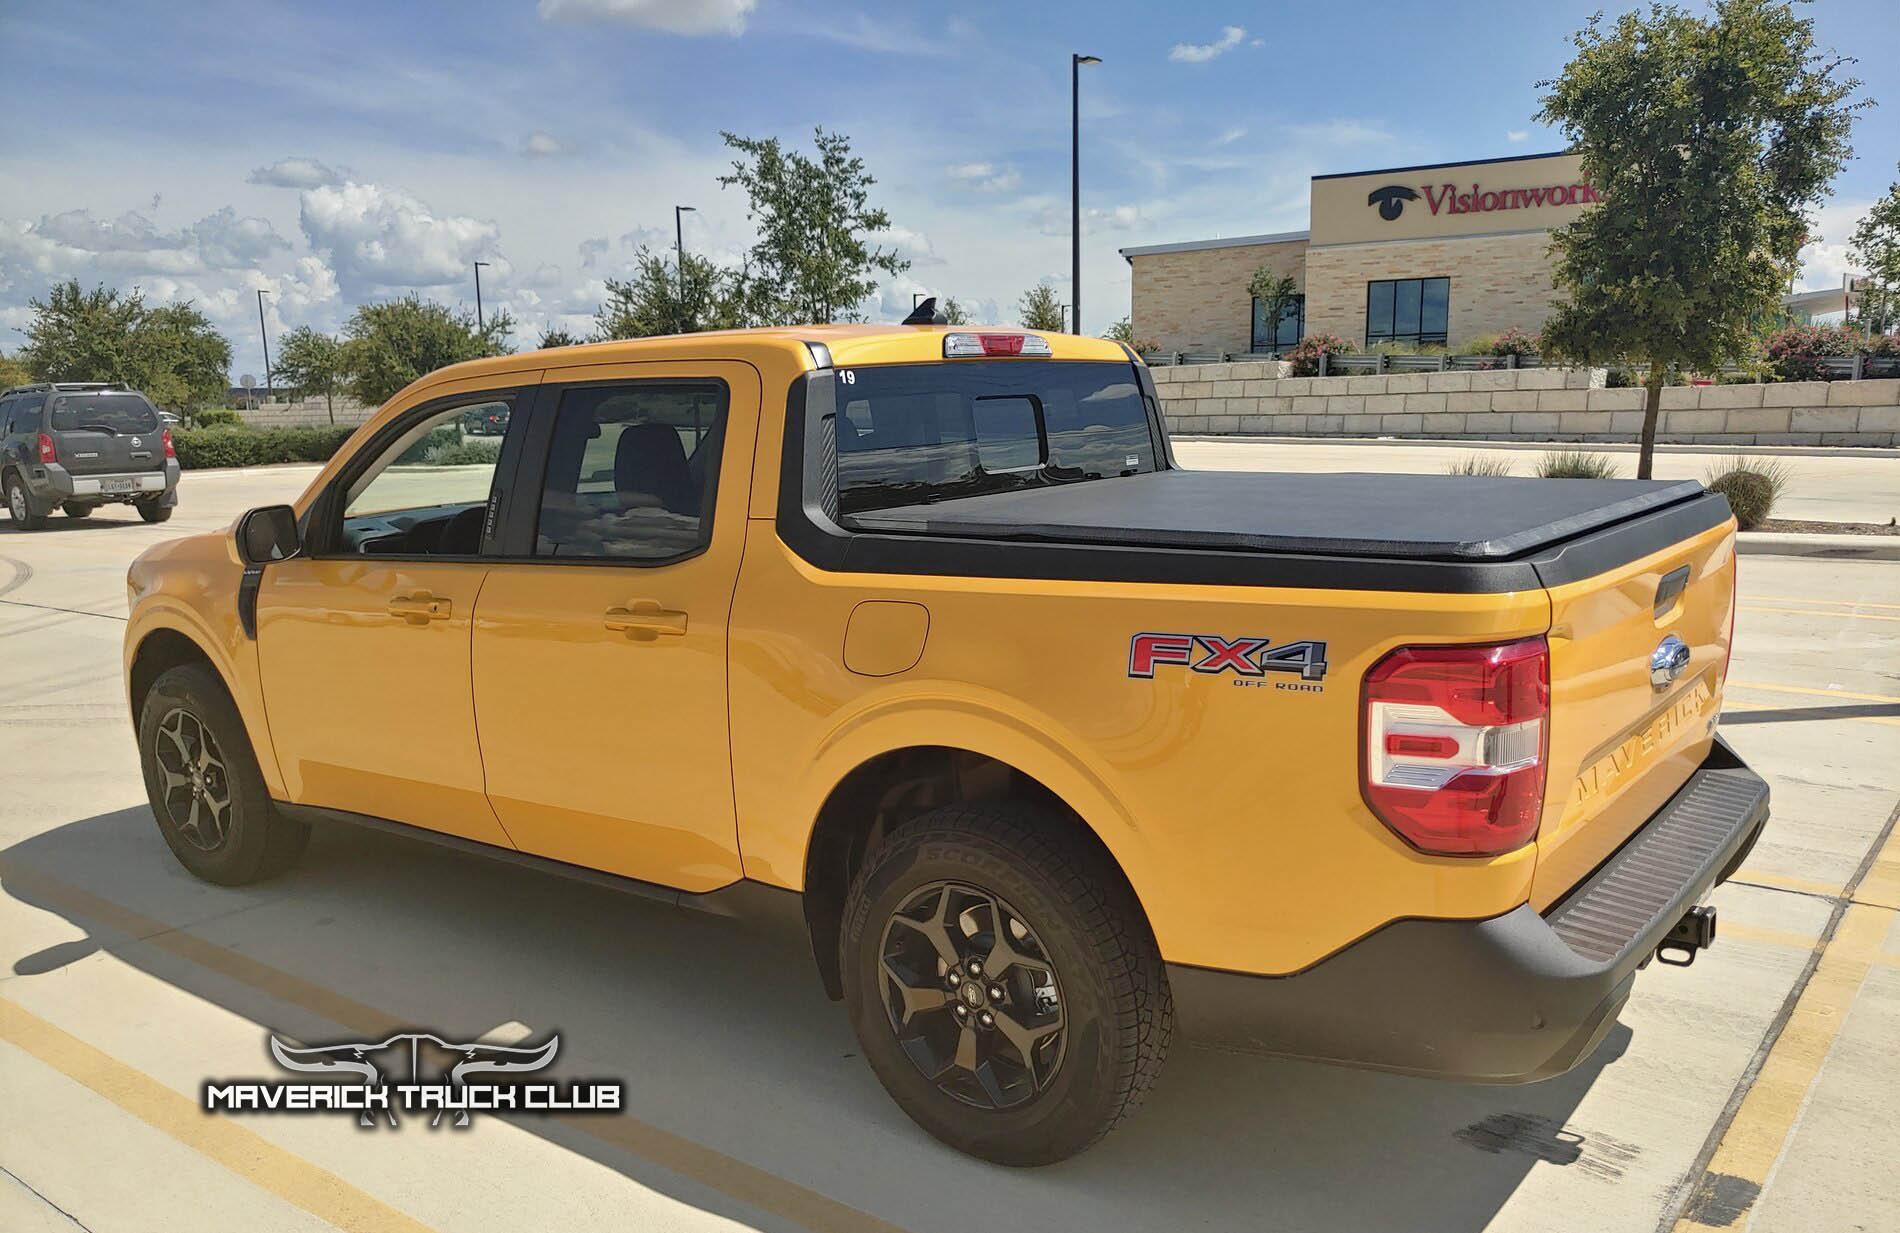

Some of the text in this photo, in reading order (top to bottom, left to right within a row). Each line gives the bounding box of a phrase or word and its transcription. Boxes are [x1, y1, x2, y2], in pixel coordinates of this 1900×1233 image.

[1421, 169, 1604, 216] Visionwork
[838, 369, 856, 385] 19
[1127, 632, 1328, 682] FX4
[1232, 678, 1324, 693] OFF ROAD
